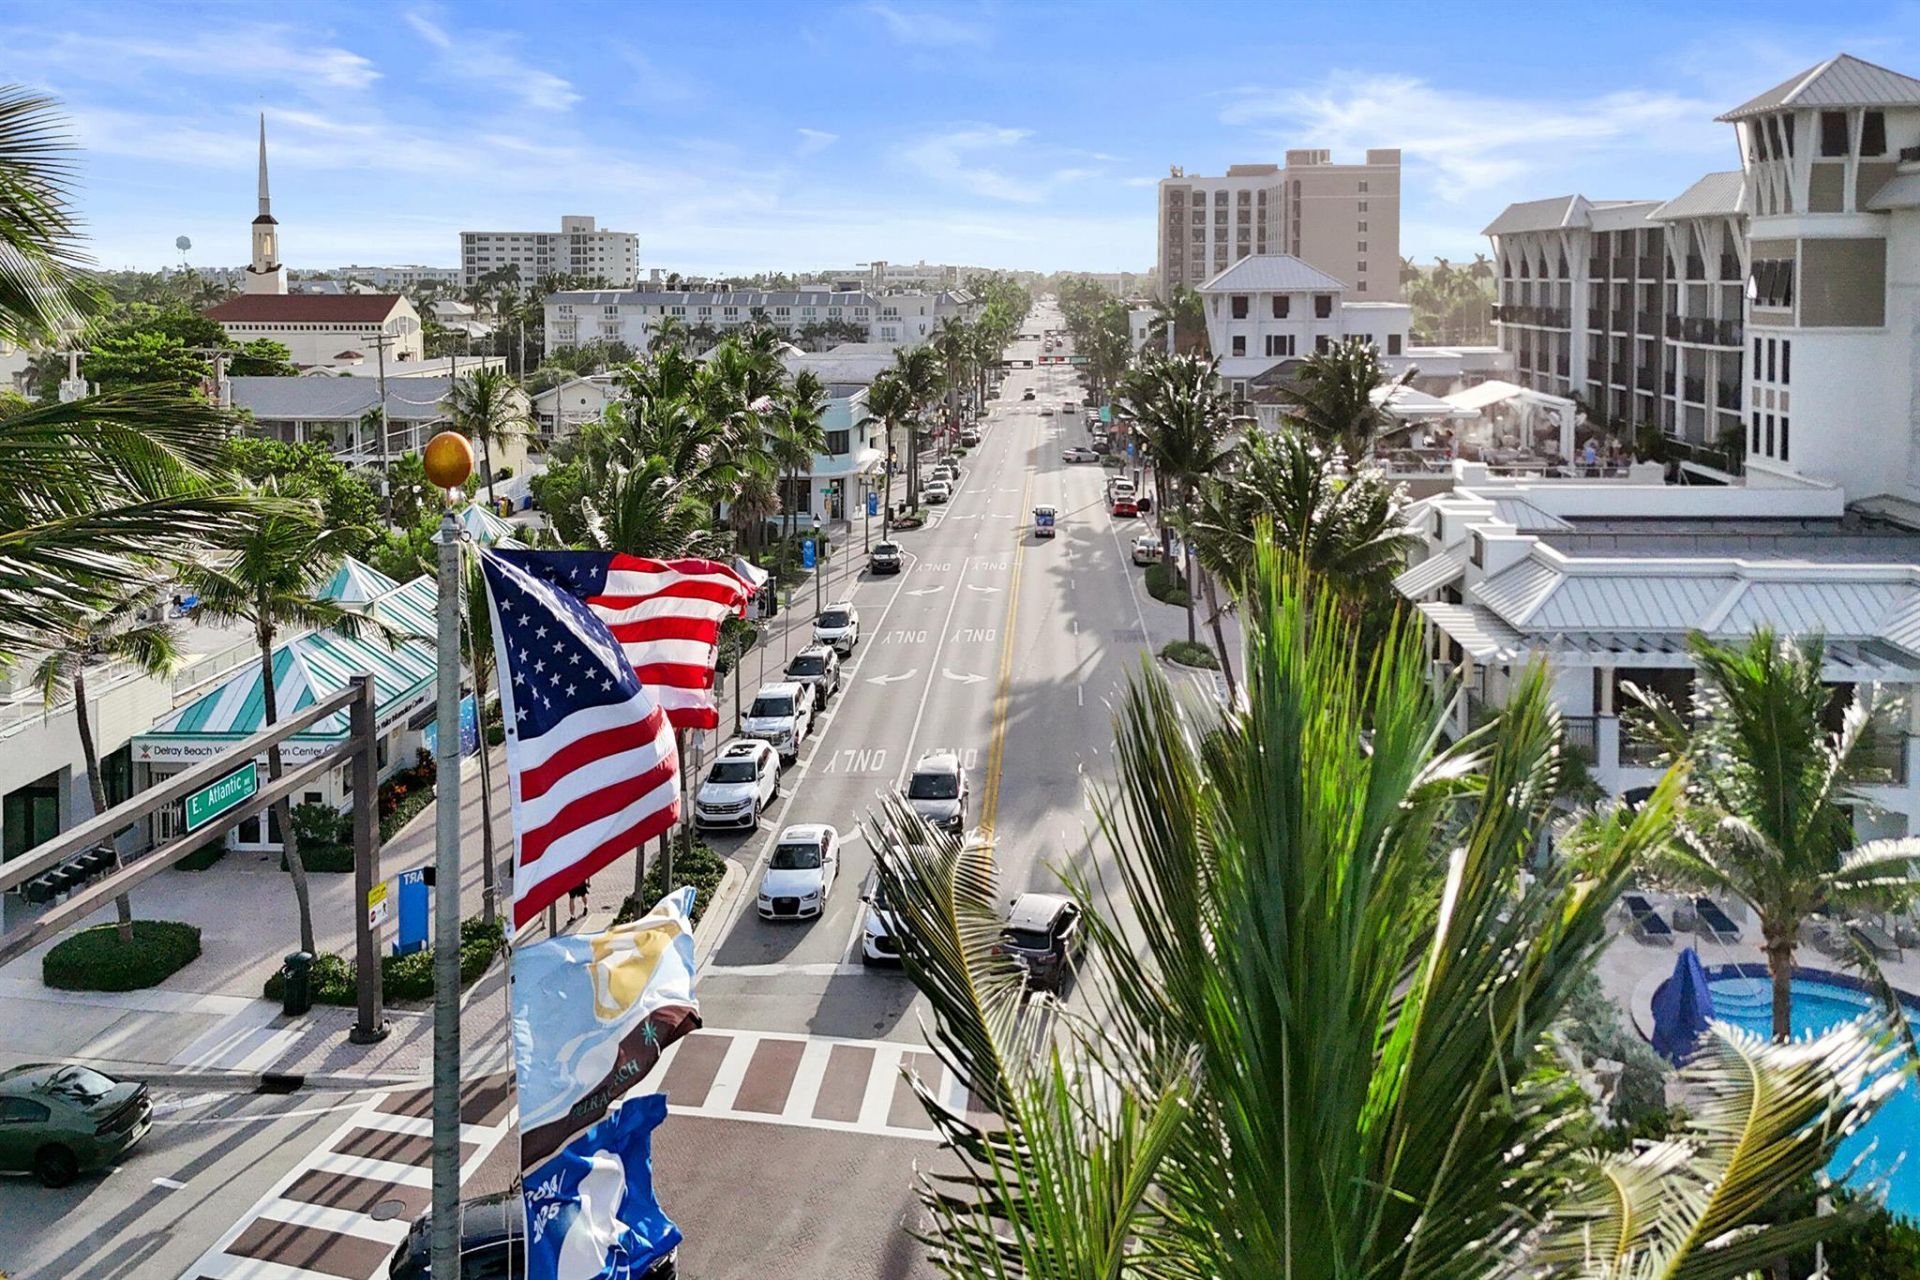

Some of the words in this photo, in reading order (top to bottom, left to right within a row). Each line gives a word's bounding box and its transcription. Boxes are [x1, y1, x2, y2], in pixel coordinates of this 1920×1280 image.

[916, 562, 952, 573] ONLY
[973, 561, 1008, 571] ONLY
[881, 630, 929, 645] ONLY
[950, 628, 997, 643] ONLY
[154, 745, 182, 757] Delray
[183, 745, 213, 756] Beach
[822, 748, 888, 774] ONLY
[192, 796, 203, 816] E.
[207, 776, 242, 807] Atlantic
